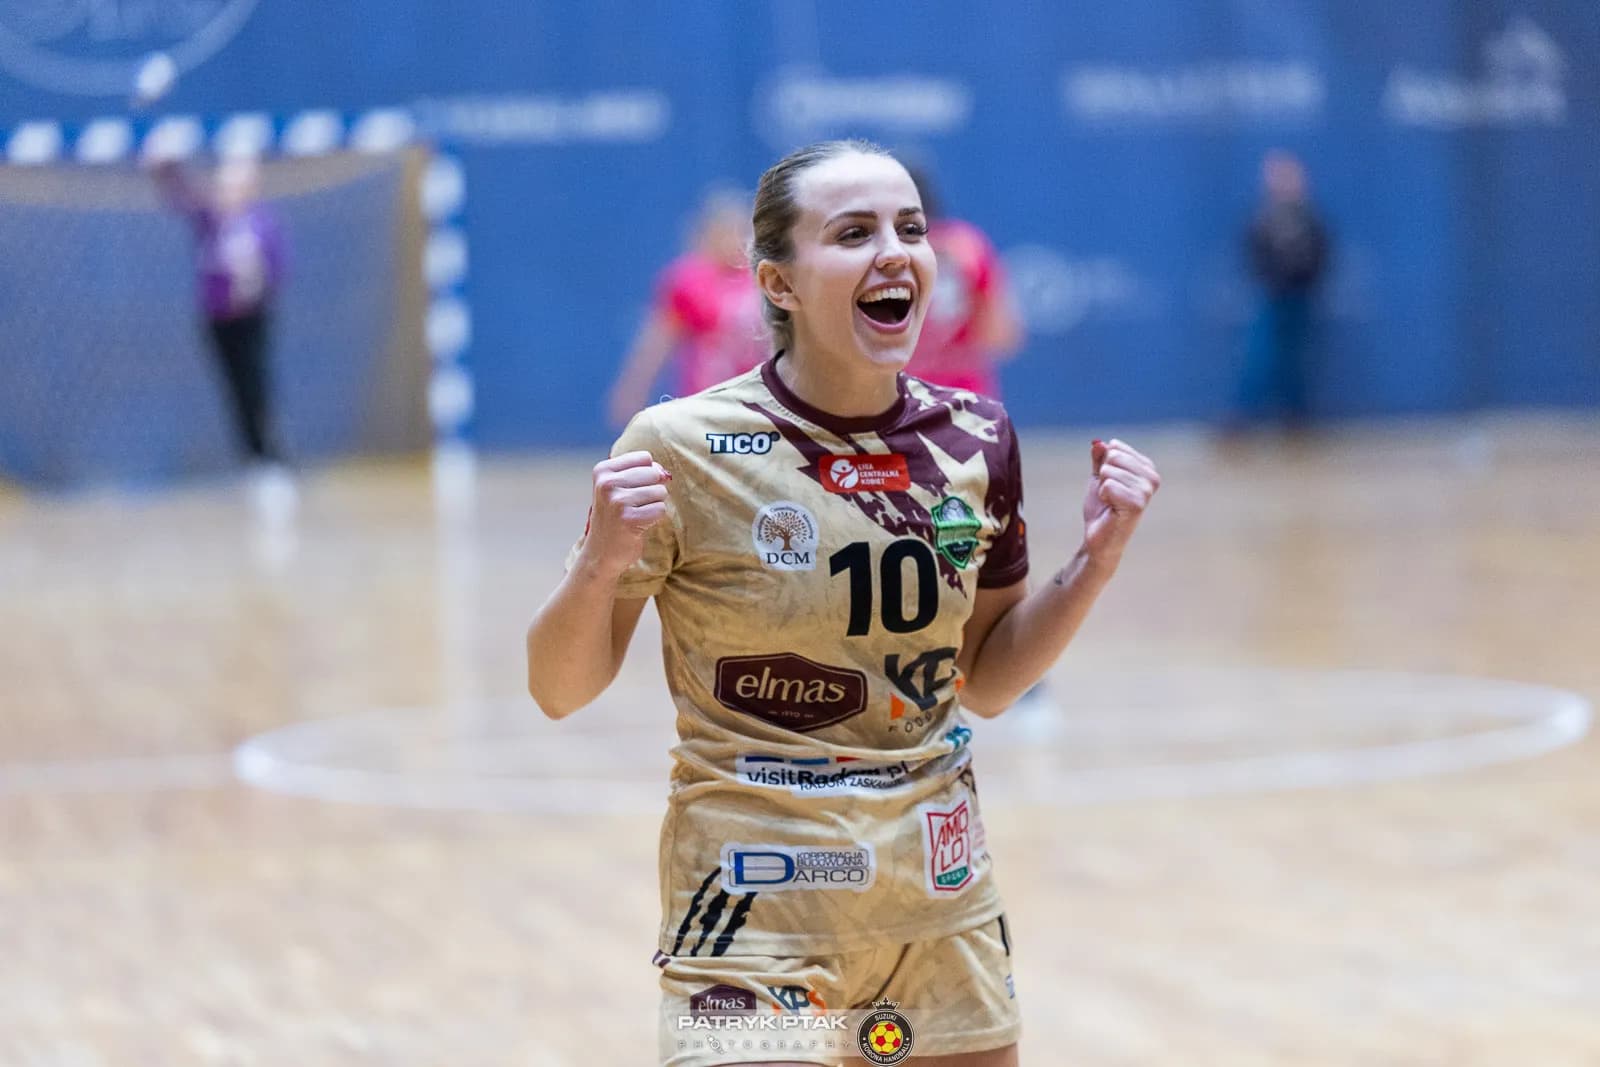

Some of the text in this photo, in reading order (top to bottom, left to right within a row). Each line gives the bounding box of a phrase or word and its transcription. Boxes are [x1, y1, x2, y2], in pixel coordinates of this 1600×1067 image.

[706, 432, 772, 455] TICO
[859, 470, 899, 478] CENTRALNA
[766, 551, 810, 565] DCM
[829, 538, 939, 636] 10
[735, 666, 847, 703] elmas
[884, 647, 966, 712] KP
[734, 852, 864, 884] DARCO
[699, 995, 746, 1013] elmas
